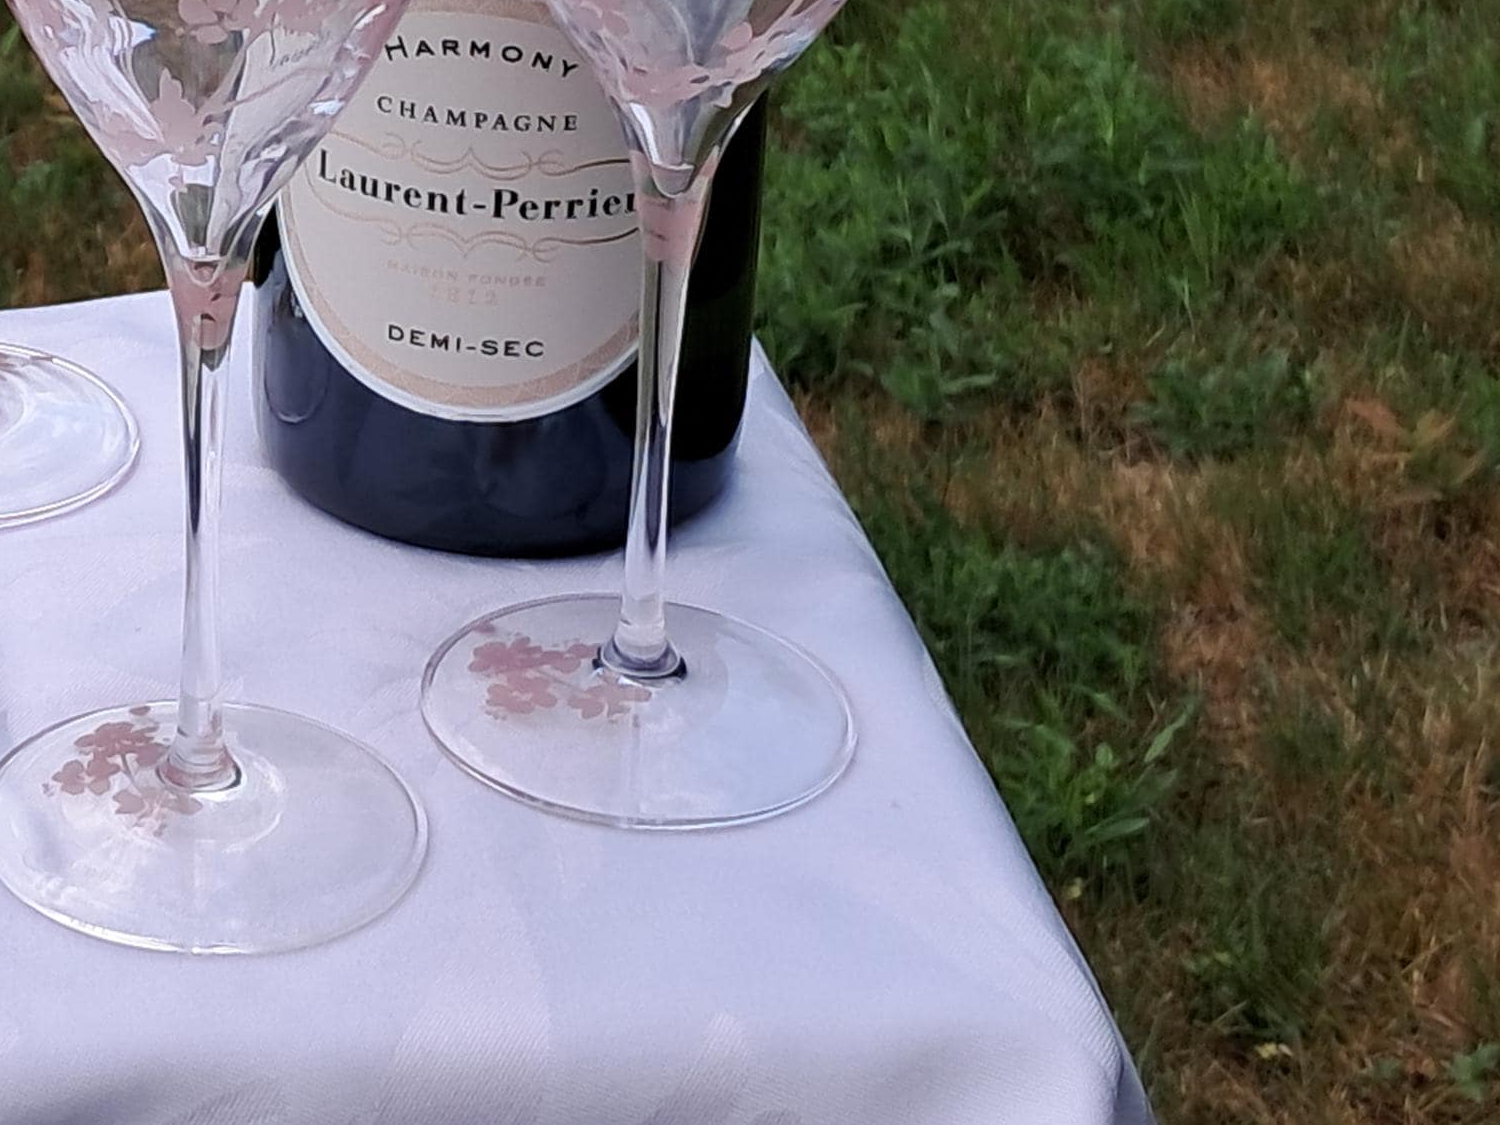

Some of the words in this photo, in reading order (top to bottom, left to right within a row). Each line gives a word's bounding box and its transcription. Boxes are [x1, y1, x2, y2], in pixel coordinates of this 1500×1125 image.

[384, 35, 579, 77] HARMONY
[376, 95, 578, 132] CHAMPAGNE
[387, 324, 545, 357] DEMI-SEC
